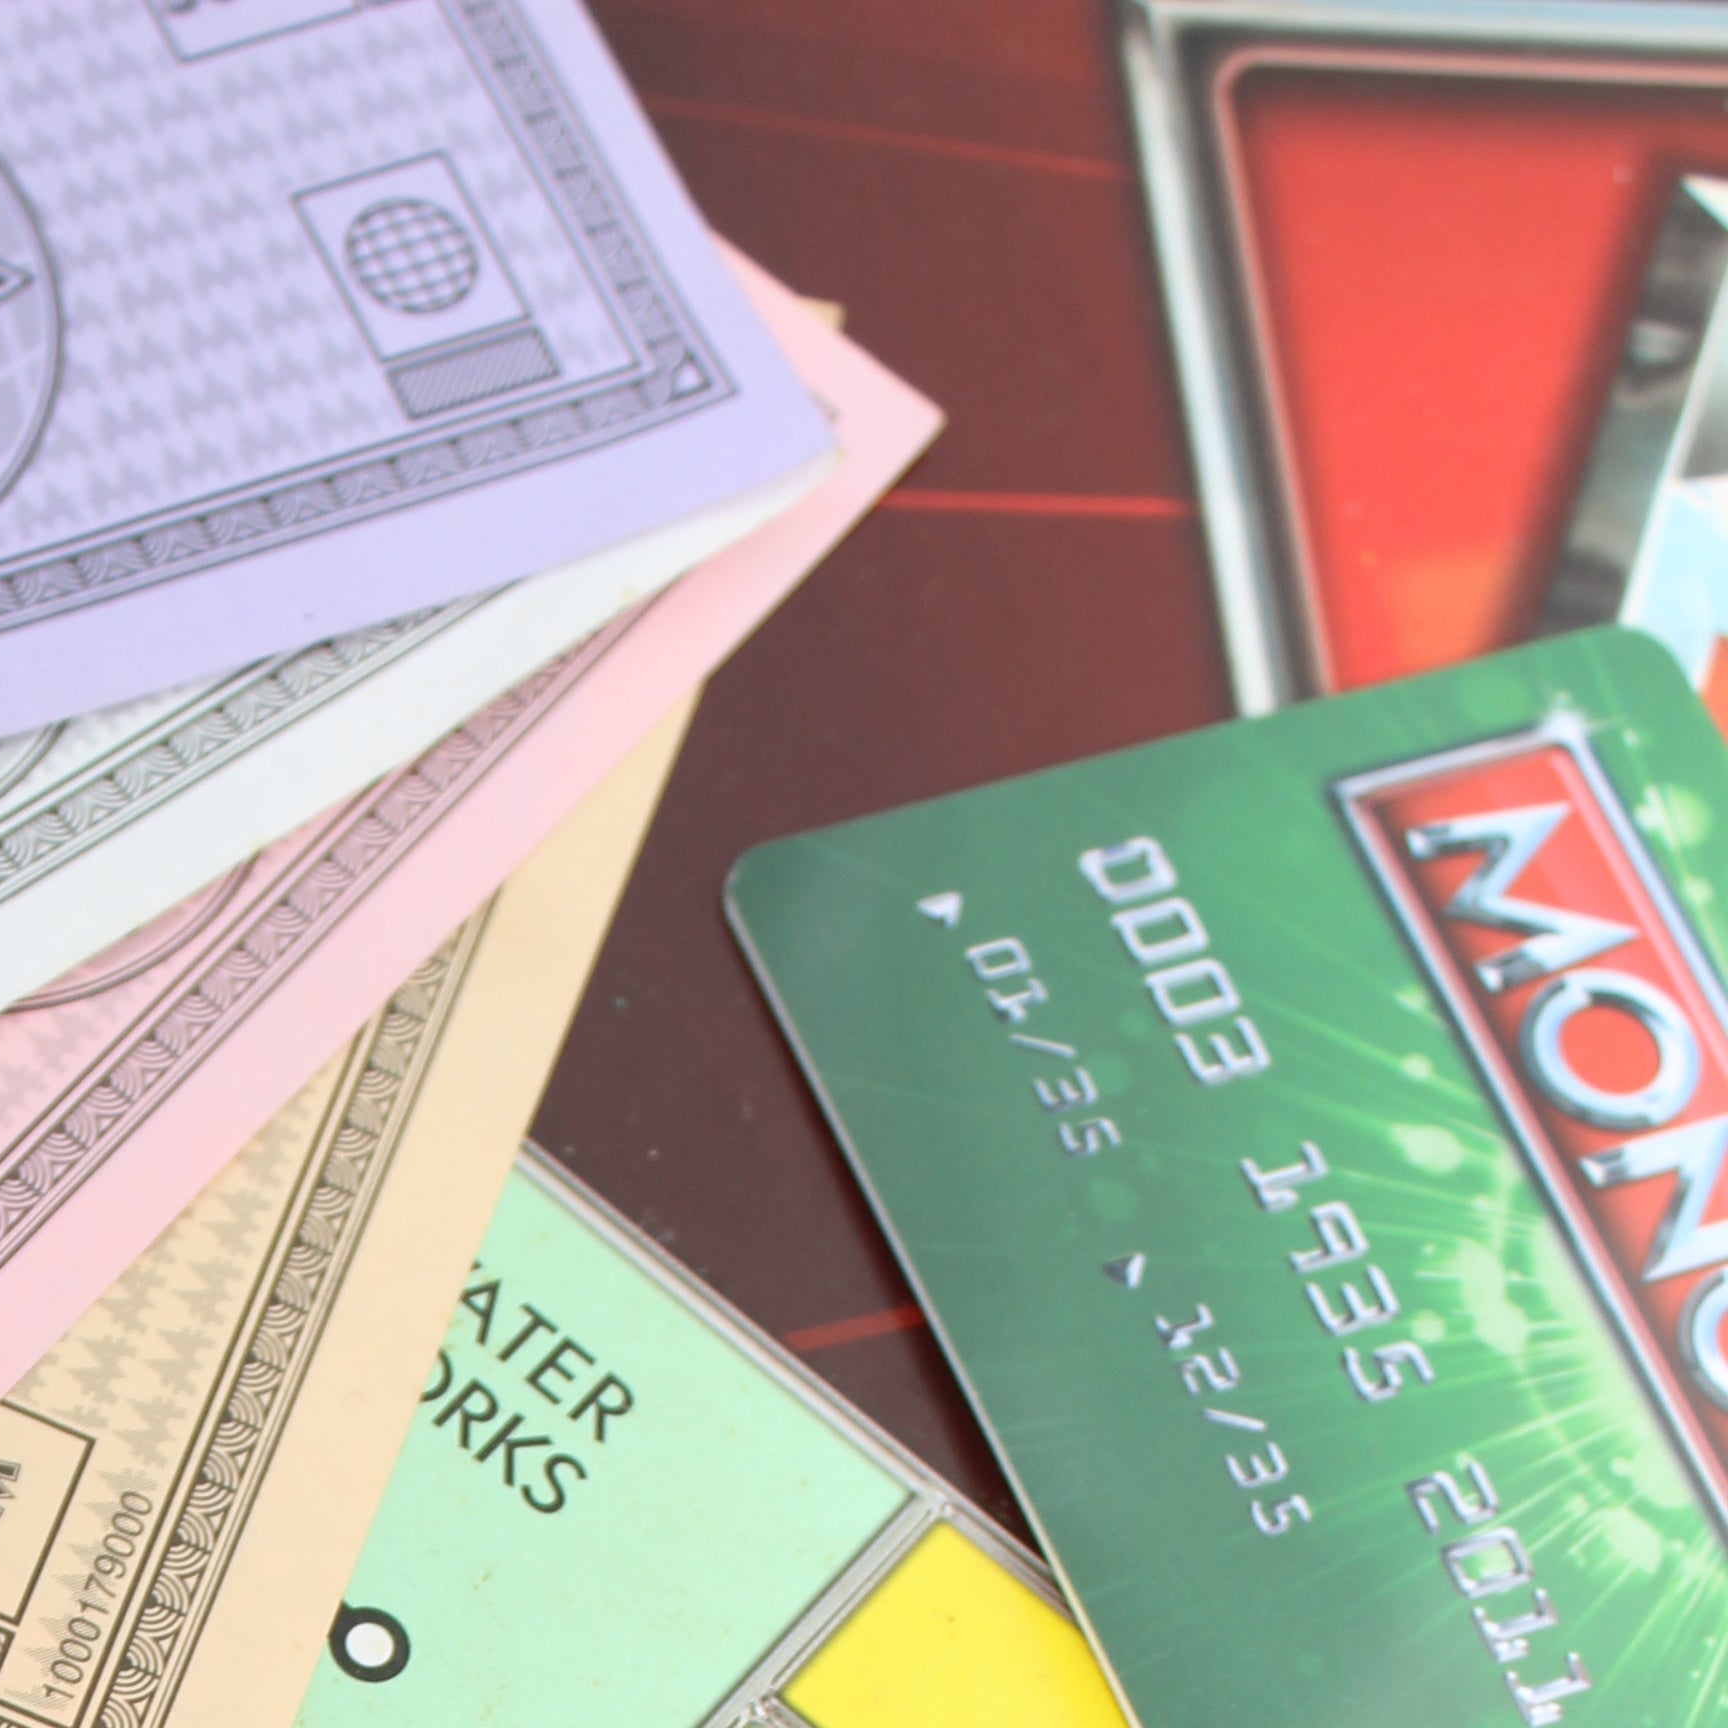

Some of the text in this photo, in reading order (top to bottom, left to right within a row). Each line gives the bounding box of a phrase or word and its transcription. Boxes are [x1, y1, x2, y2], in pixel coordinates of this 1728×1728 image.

[1405, 800, 1728, 1412] MON
[458, 1258, 635, 1443] ATER
[1079, 836, 1271, 1086] 0003
[1240, 1140, 1435, 1402] 1935
[1405, 1460, 1592, 1728] 2011
[1156, 1303, 1312, 1536] 12/35
[42, 1490, 154, 1699] 1000179000
